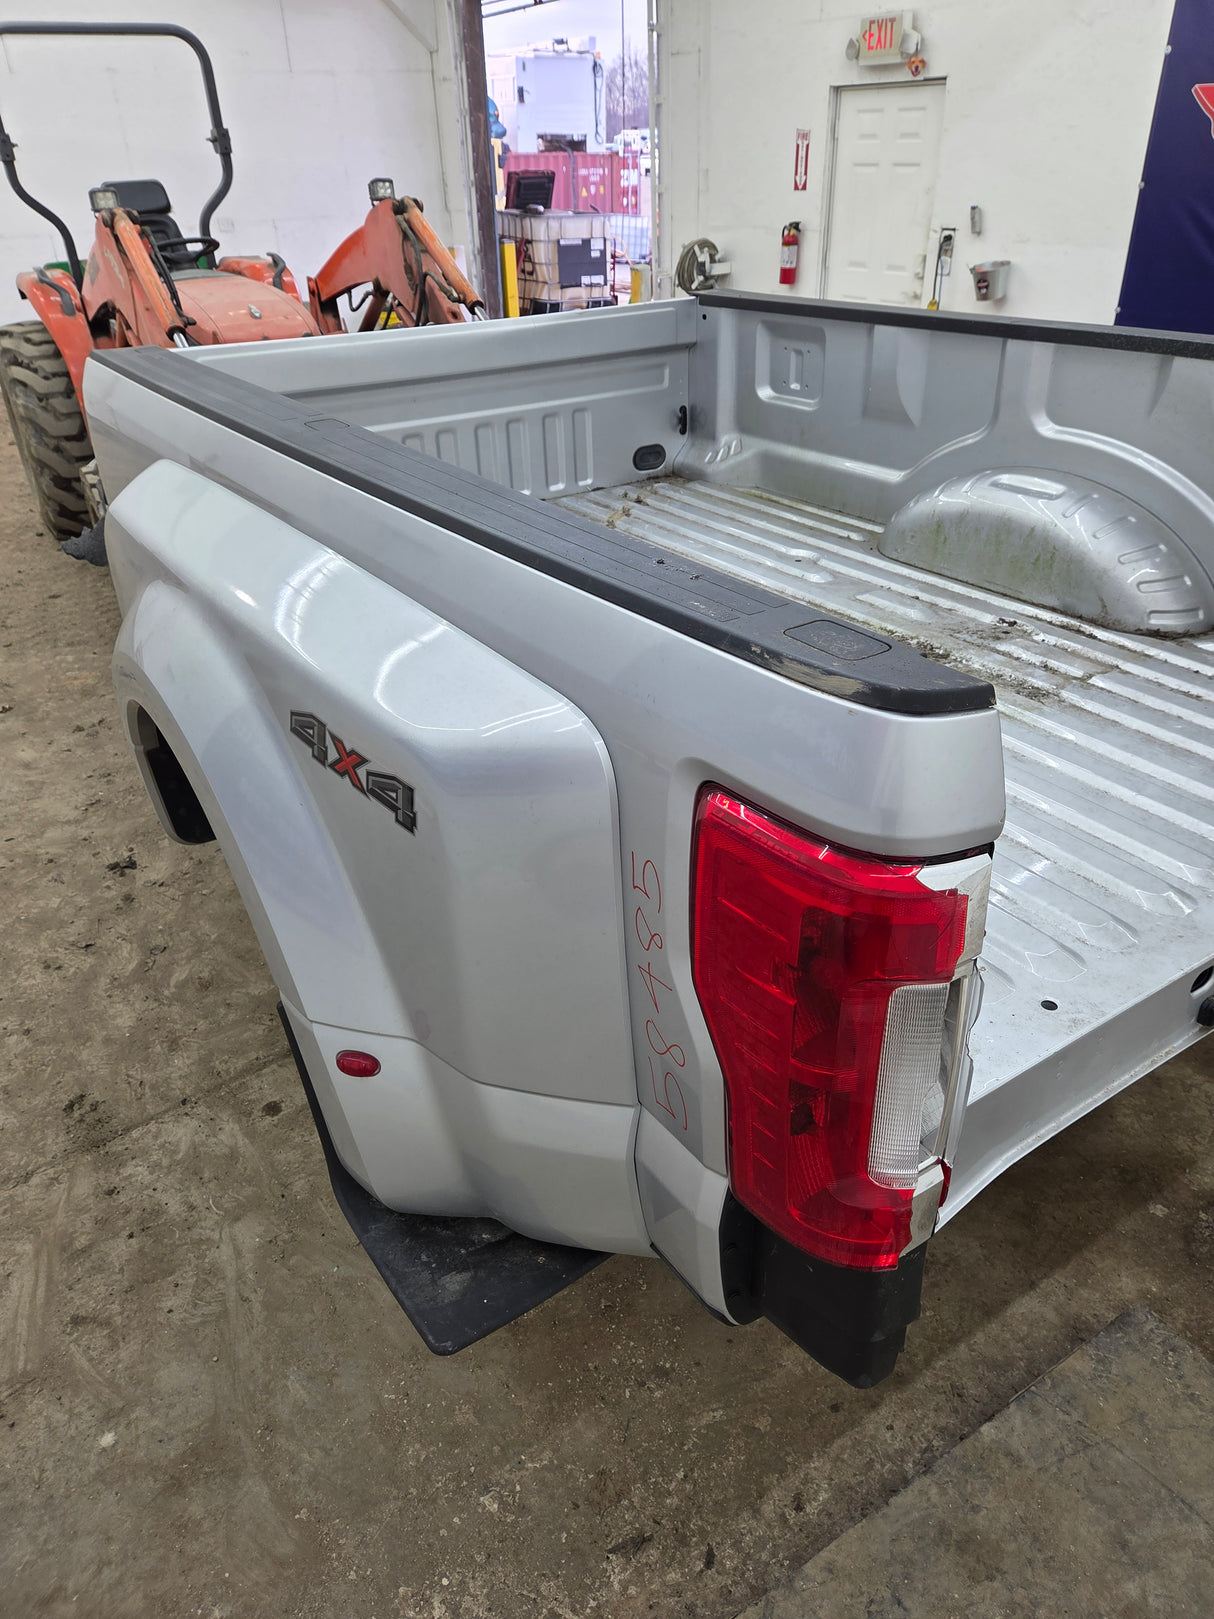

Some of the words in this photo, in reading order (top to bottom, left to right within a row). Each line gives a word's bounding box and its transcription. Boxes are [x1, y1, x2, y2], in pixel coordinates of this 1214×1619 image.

[867, 17, 897, 51] EXIT
[290, 710, 417, 836] 4X4
[631, 851, 688, 1131] 58485
